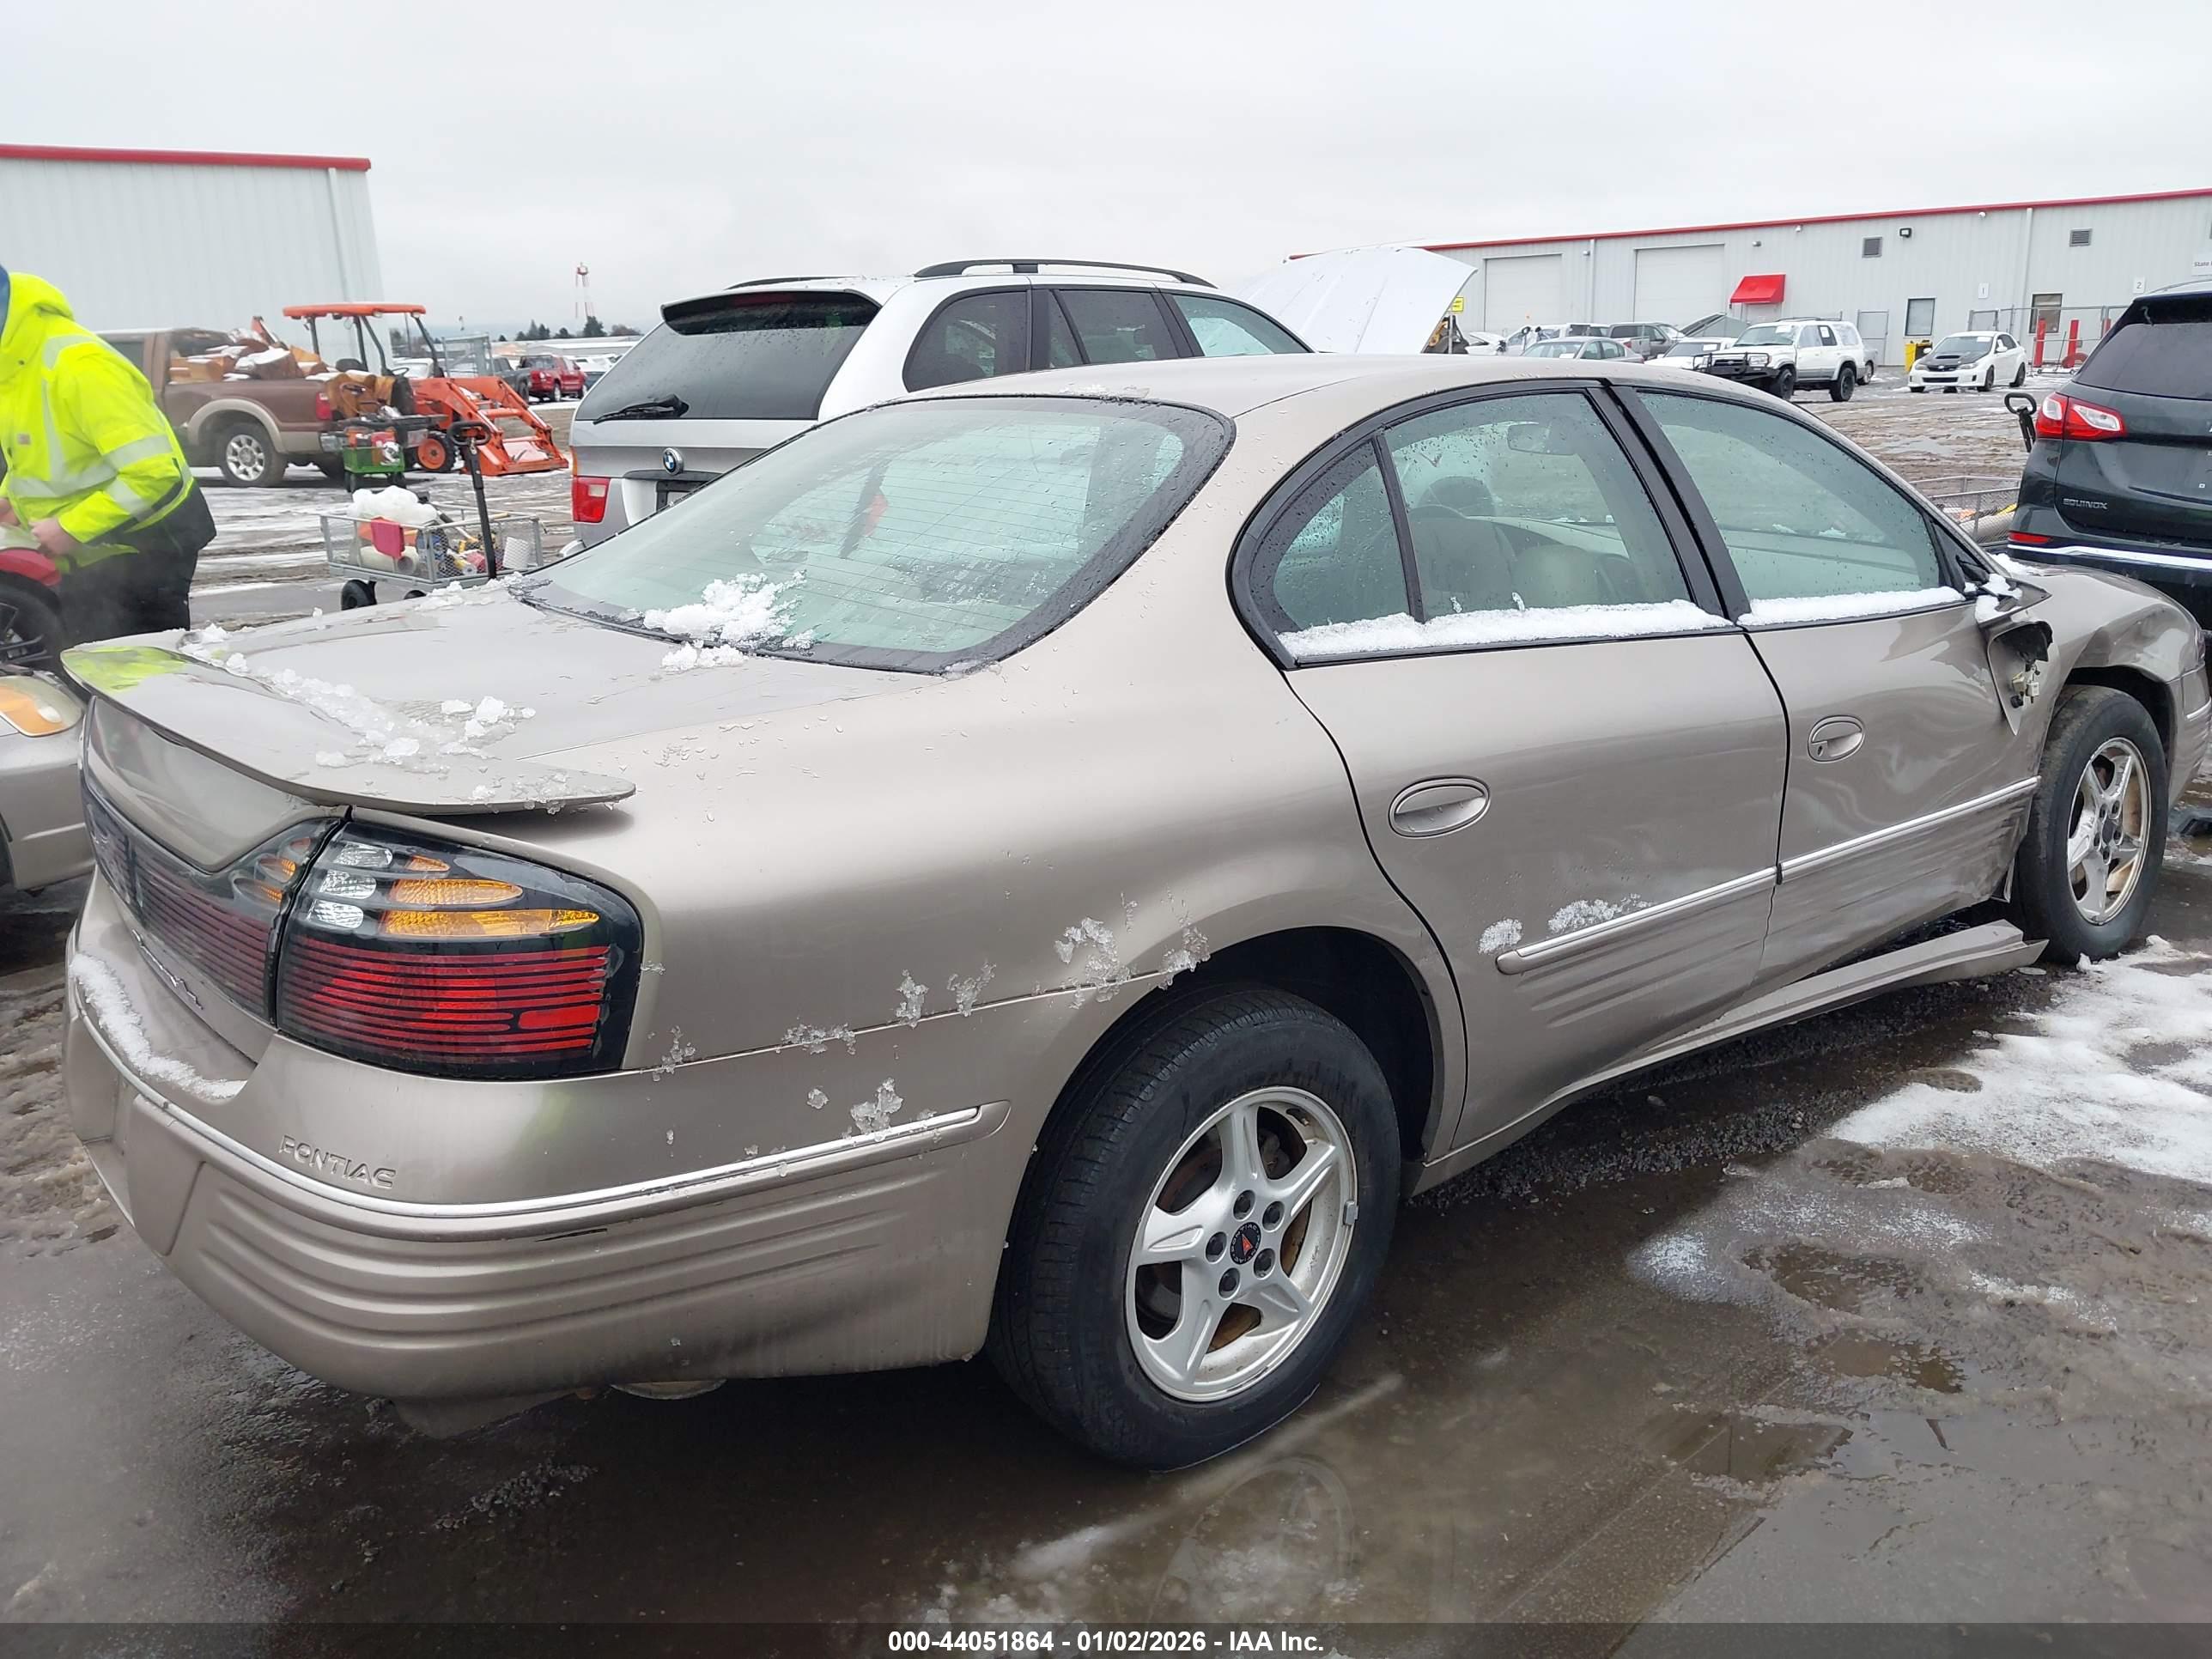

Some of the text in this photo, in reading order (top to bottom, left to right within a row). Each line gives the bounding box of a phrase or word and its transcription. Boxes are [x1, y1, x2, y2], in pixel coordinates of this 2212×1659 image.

[2136, 281, 2142, 289] 2
[2063, 498, 2108, 509] EQUINOX
[278, 1133, 397, 1189] PONTIAC
